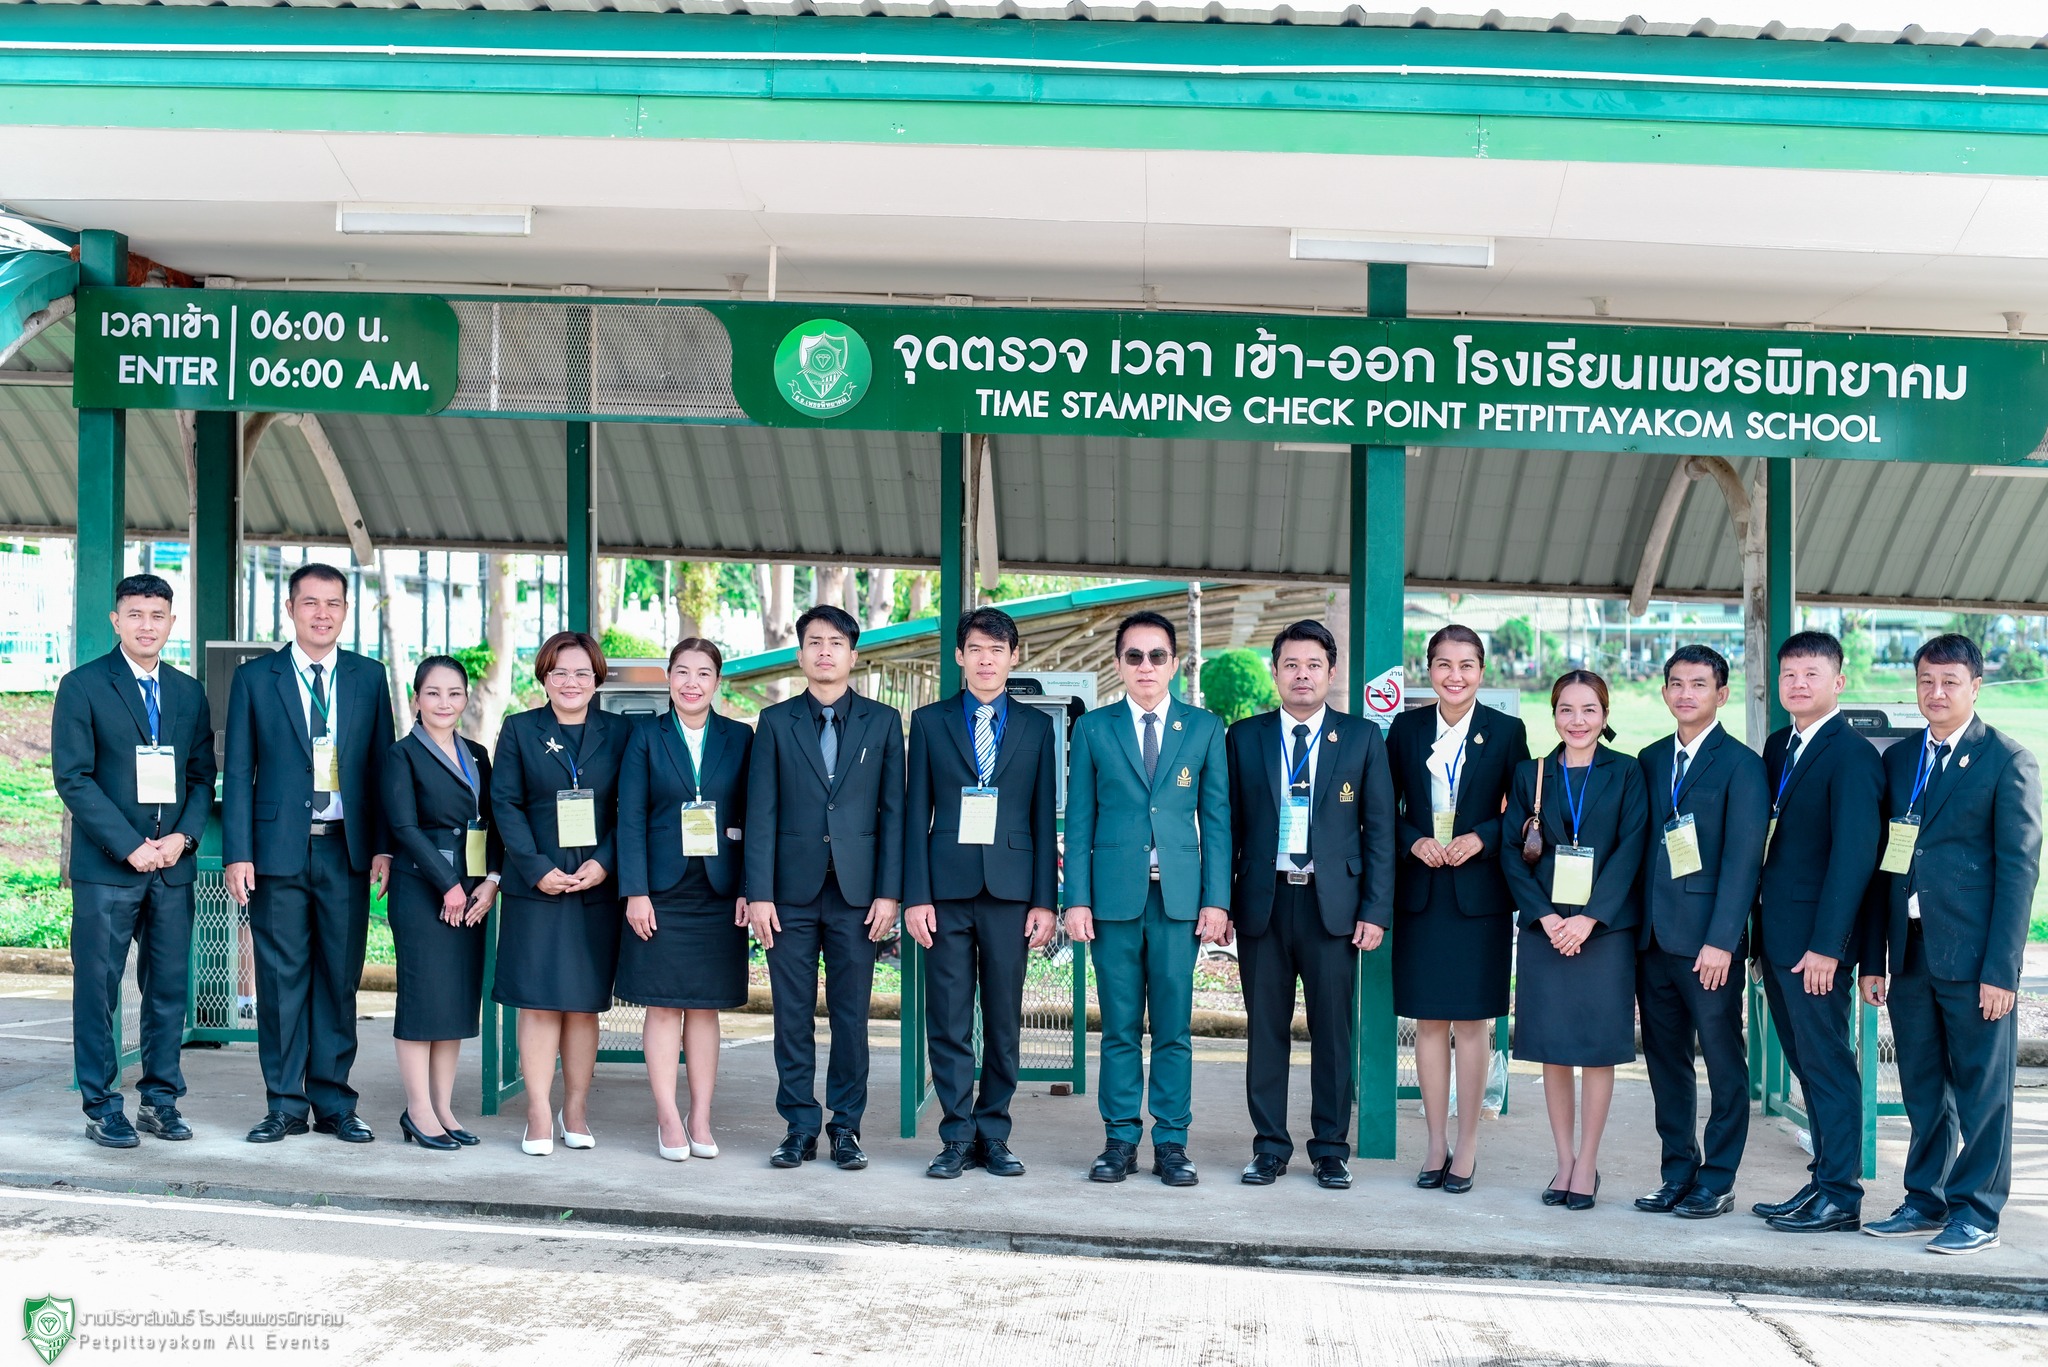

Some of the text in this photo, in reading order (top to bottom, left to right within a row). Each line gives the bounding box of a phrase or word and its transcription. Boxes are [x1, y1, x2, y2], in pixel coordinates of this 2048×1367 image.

[101, 302, 220, 339] เวลาเข้า
[250, 309, 389, 343] 06:00 น.
[118, 355, 219, 386] ENTER
[249, 357, 430, 391] 06:00 A.M.
[893, 327, 1967, 401] จุดตรวจ เวลา เข้า-ออก โรงเรียนเพชรพิทยาคม
[975, 388, 1882, 443] TIME STAMPING CHECK POINT PETPITTAYAKOM SCHOOL
